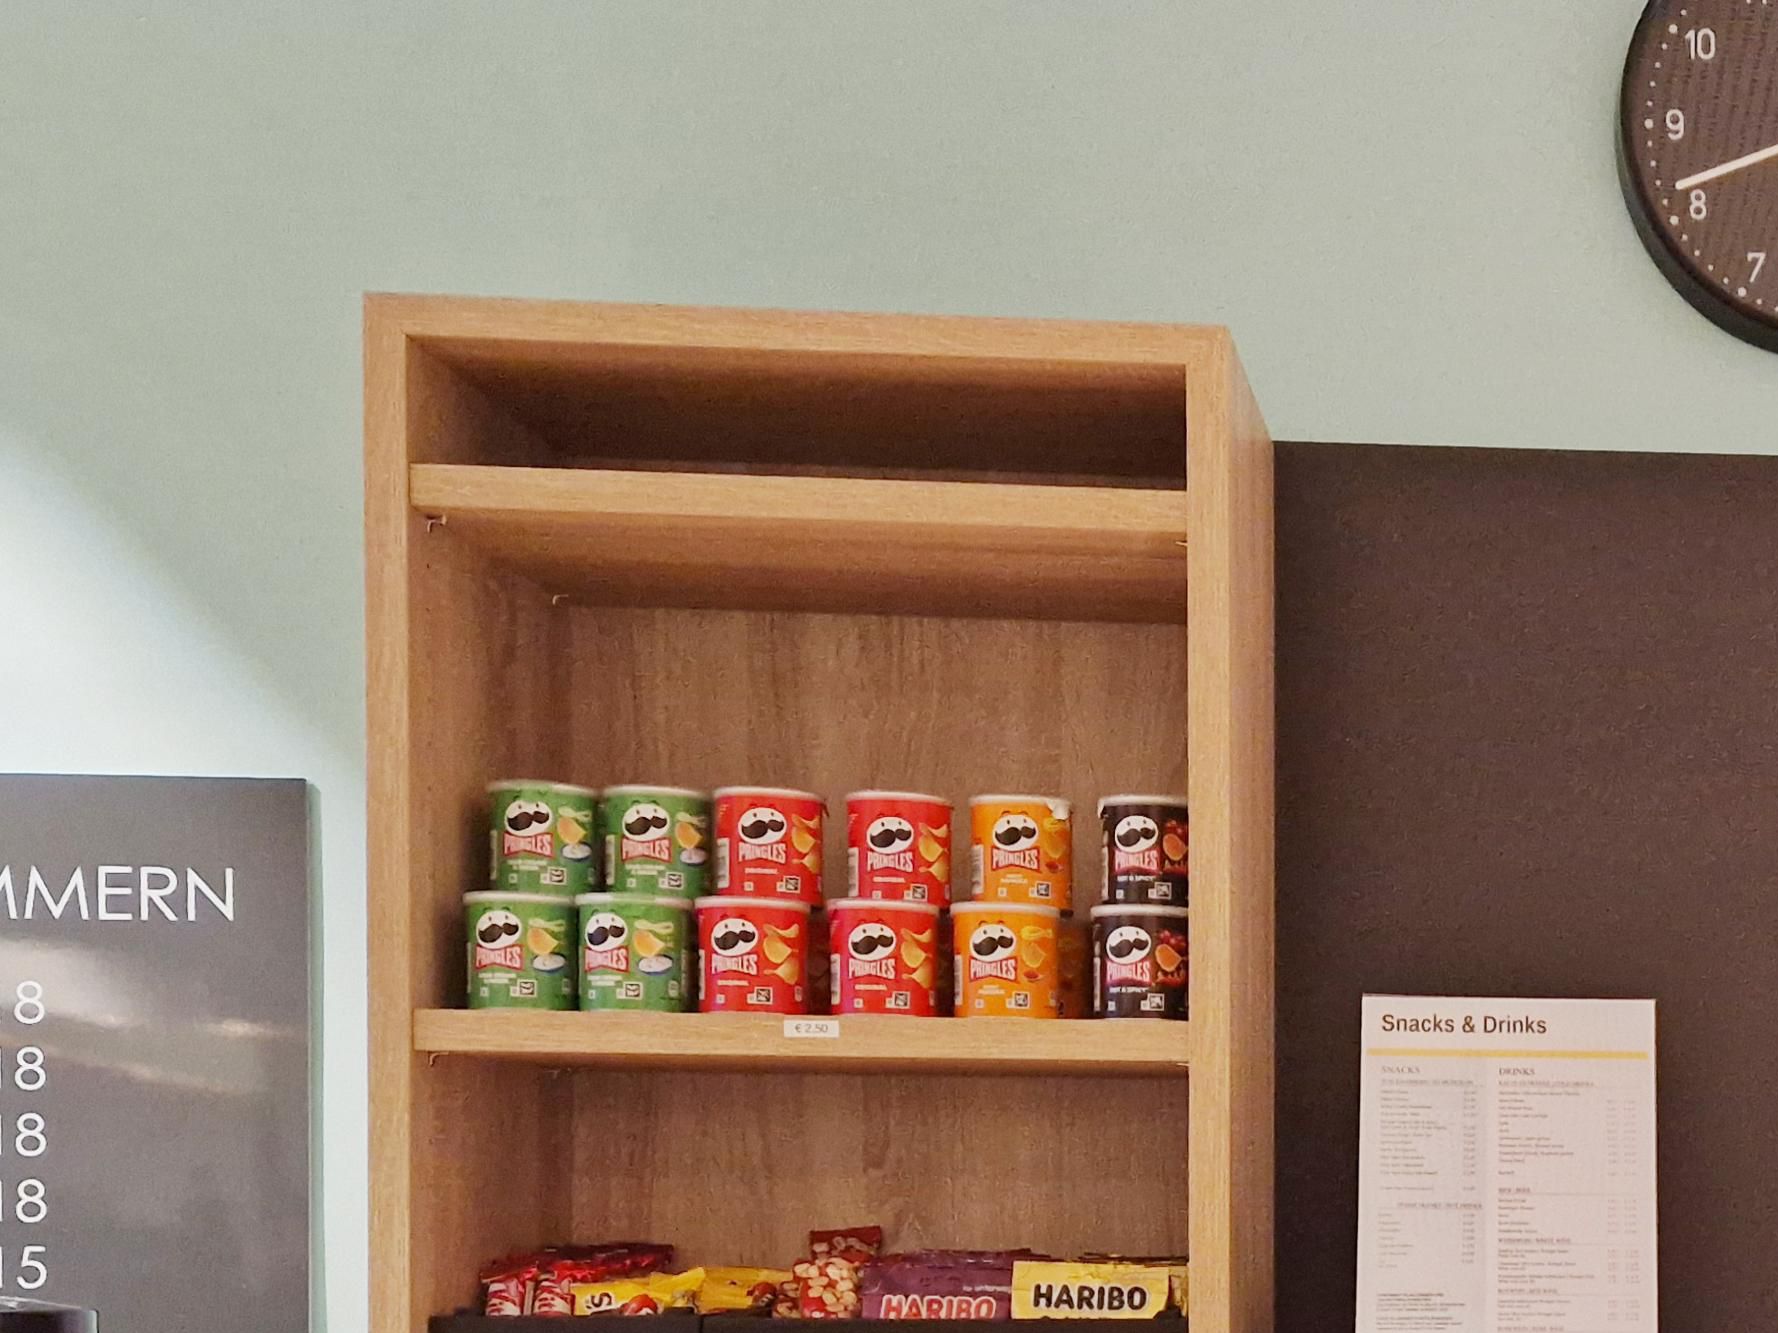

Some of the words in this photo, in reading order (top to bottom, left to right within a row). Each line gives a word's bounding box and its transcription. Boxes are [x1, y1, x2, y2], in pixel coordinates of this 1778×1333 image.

[1685, 28, 1716, 60] 10
[1665, 109, 1685, 140] 9
[1689, 189, 1708, 220] 8
[1747, 252, 1766, 282] 7
[739, 841, 787, 864] PRINGLES
[867, 852, 914, 873] PRINGLES
[992, 849, 1040, 871] PRINGLES
[1115, 850, 1159, 872] PRINGLES
[0, 865, 236, 922] MERN
[711, 954, 758, 976] PRINGLES
[849, 957, 896, 980] PRINGLES
[970, 959, 1016, 980] PRINGLES
[1106, 961, 1150, 983] PRINGLES
[1381, 1014, 1455, 1033] Snacks
[1462, 1015, 1476, 1034] &
[1483, 1015, 1548, 1034] Drinks
[881, 1295, 997, 1319] HARIBO
[1032, 1283, 1148, 1311] HARIBO
